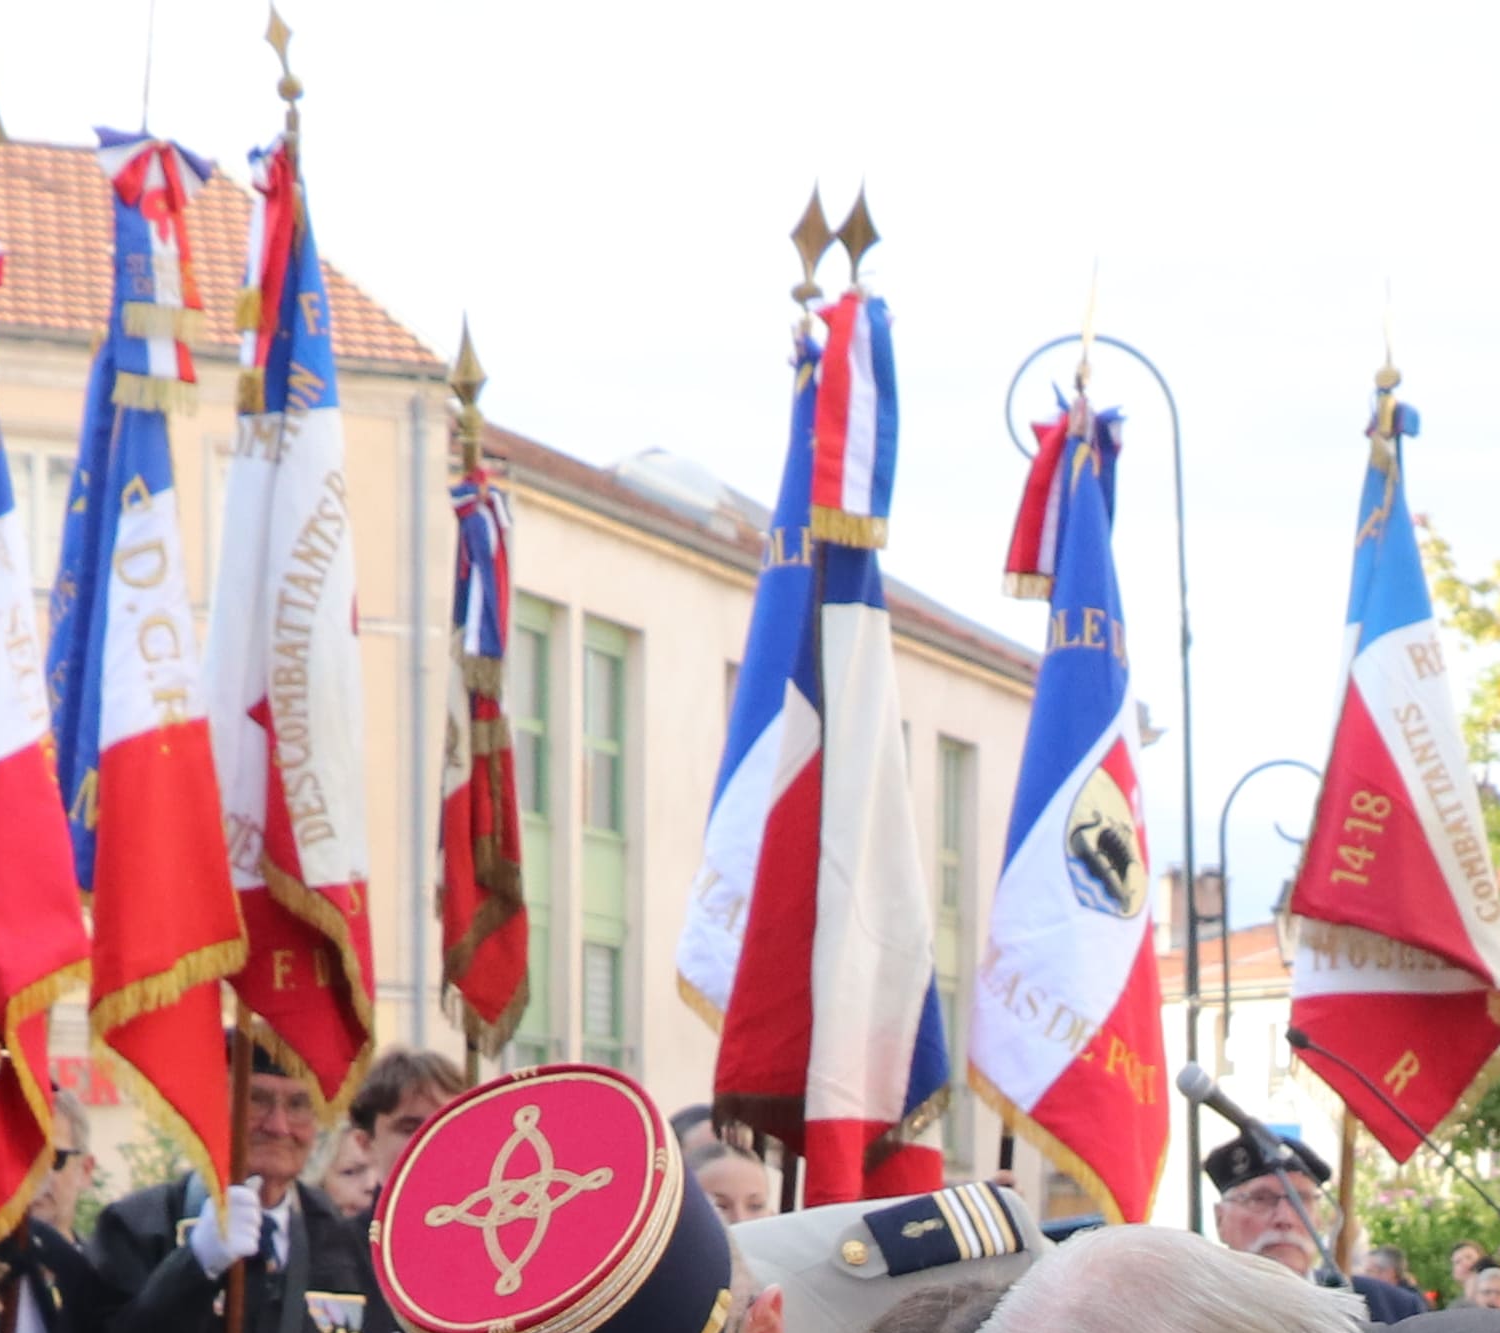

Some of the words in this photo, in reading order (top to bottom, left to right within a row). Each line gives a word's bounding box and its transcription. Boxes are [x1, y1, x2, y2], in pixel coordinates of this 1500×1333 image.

[273, 497, 346, 769] COMBATTANTS
[1331, 790, 1392, 887] 14-18
[1393, 702, 1500, 923] COMBATTANTS
